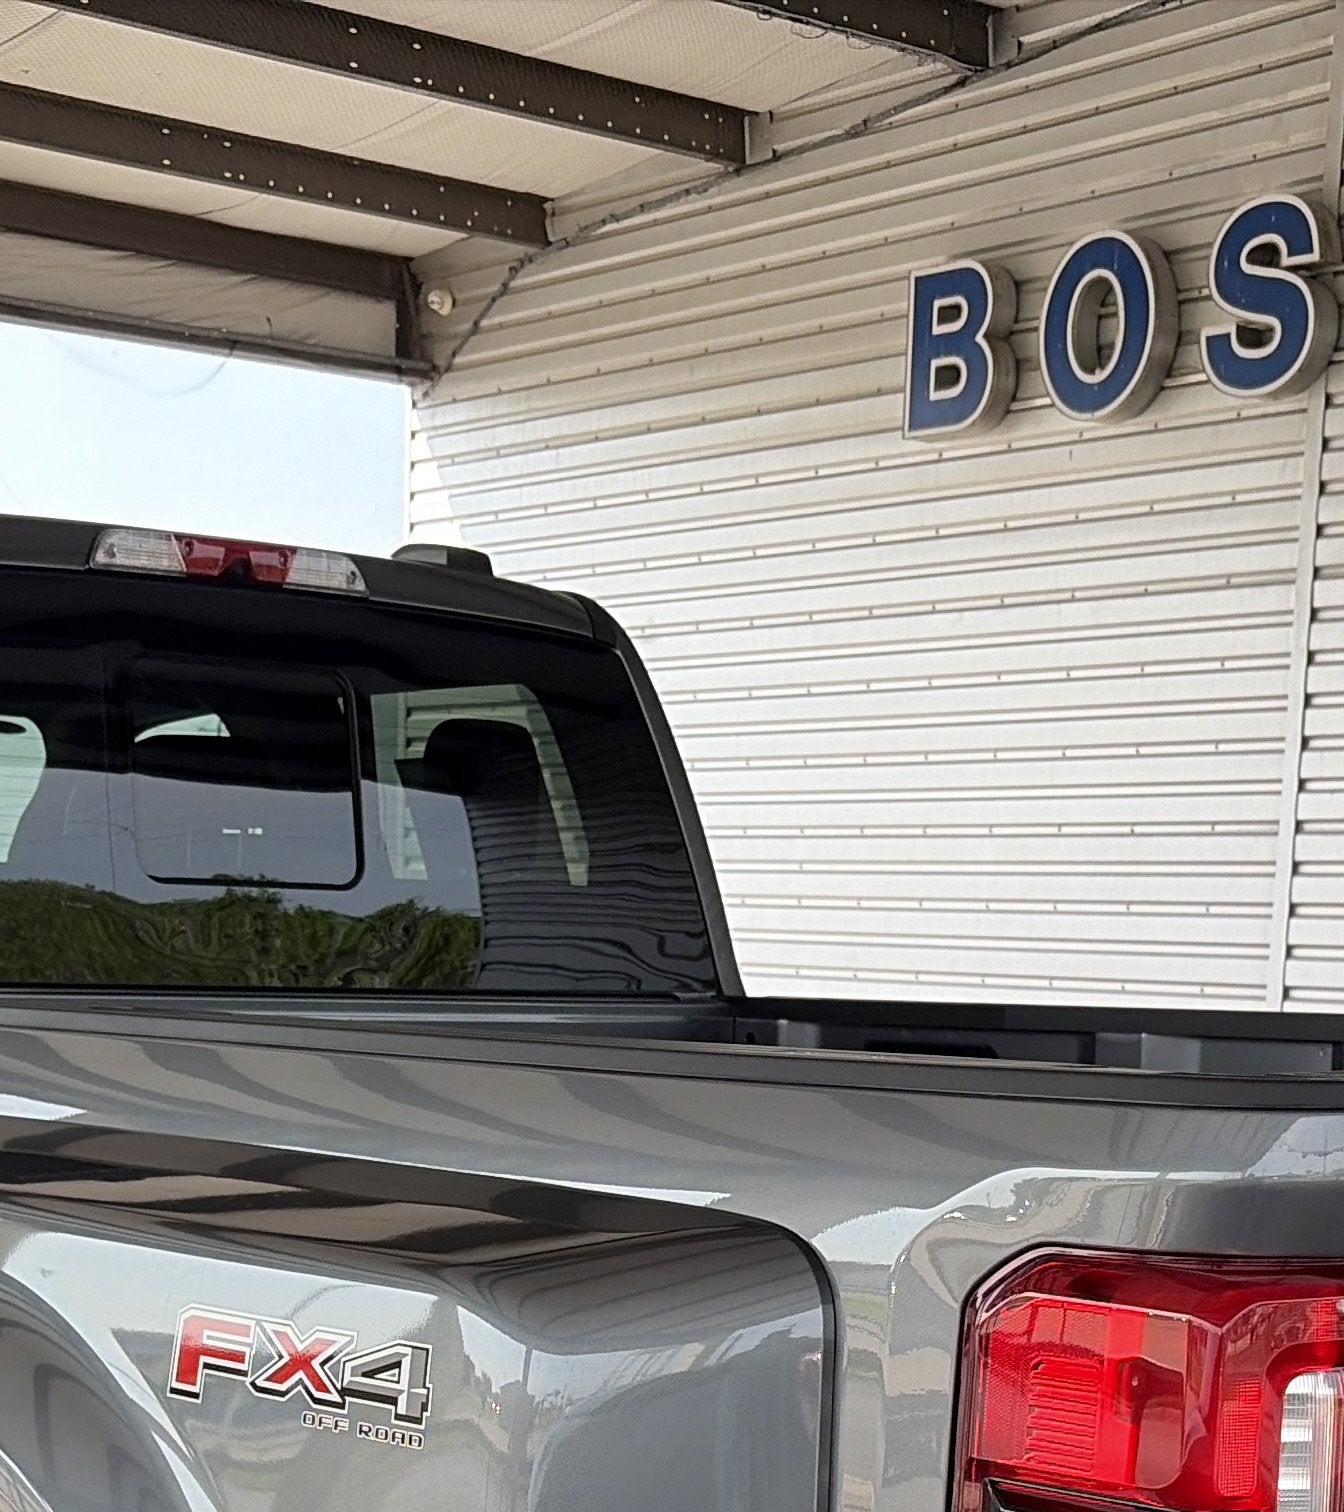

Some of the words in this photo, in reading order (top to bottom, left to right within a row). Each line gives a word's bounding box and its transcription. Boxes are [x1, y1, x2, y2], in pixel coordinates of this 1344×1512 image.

[167, 1303, 432, 1429] FX4
[301, 1411, 349, 1433] OFF
[357, 1421, 424, 1449] ROAD
